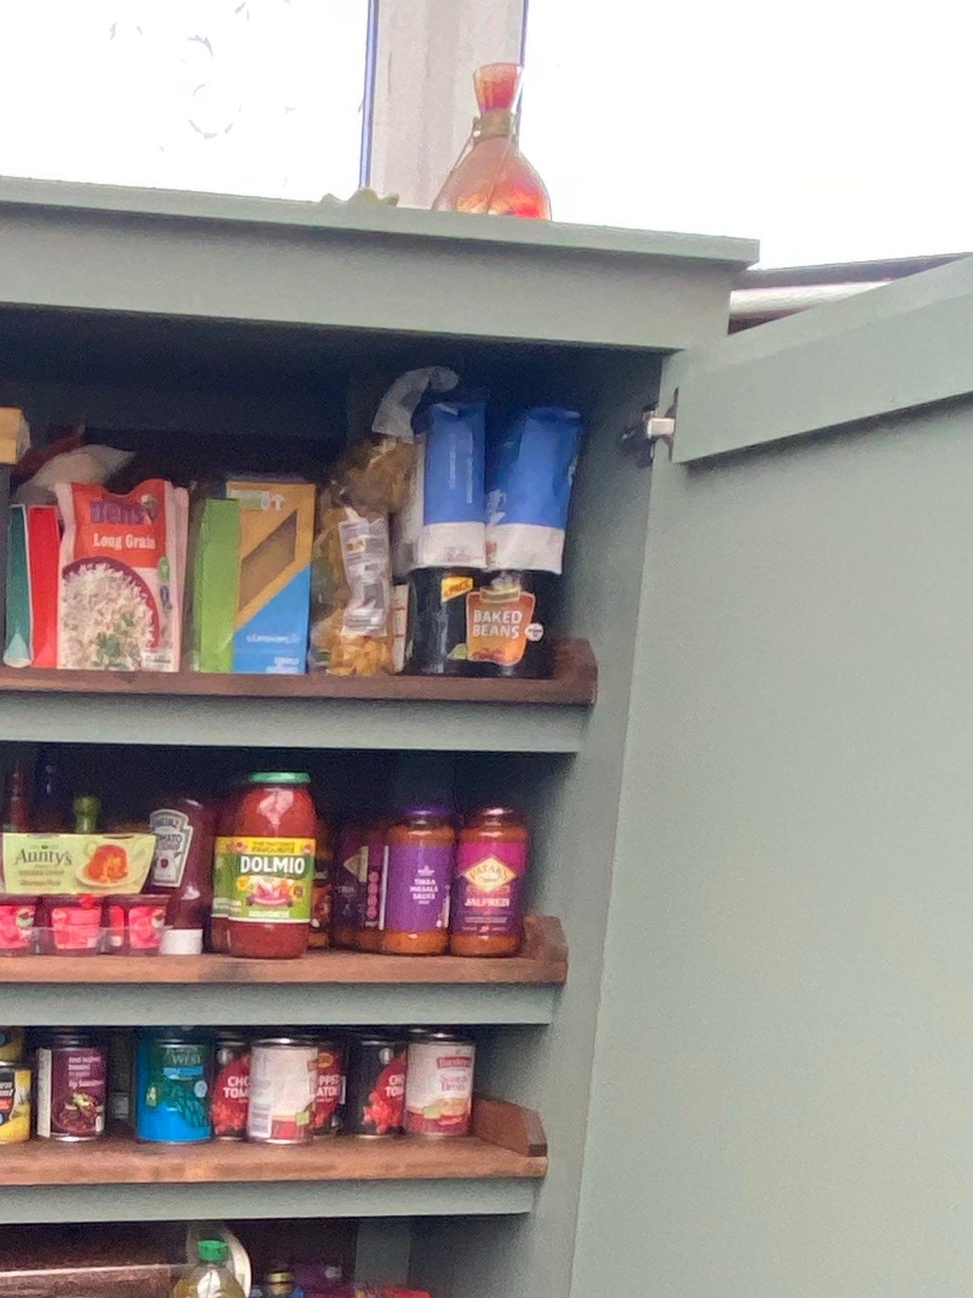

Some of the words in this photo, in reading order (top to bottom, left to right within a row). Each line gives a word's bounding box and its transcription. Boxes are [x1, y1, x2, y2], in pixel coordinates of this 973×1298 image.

[93, 533, 123, 551] Long
[125, 534, 156, 550] Grain
[473, 608, 523, 625] BAKED
[472, 623, 520, 640] BEANS
[11, 848, 73, 866] Aunty's
[240, 855, 306, 875] DOLMIO
